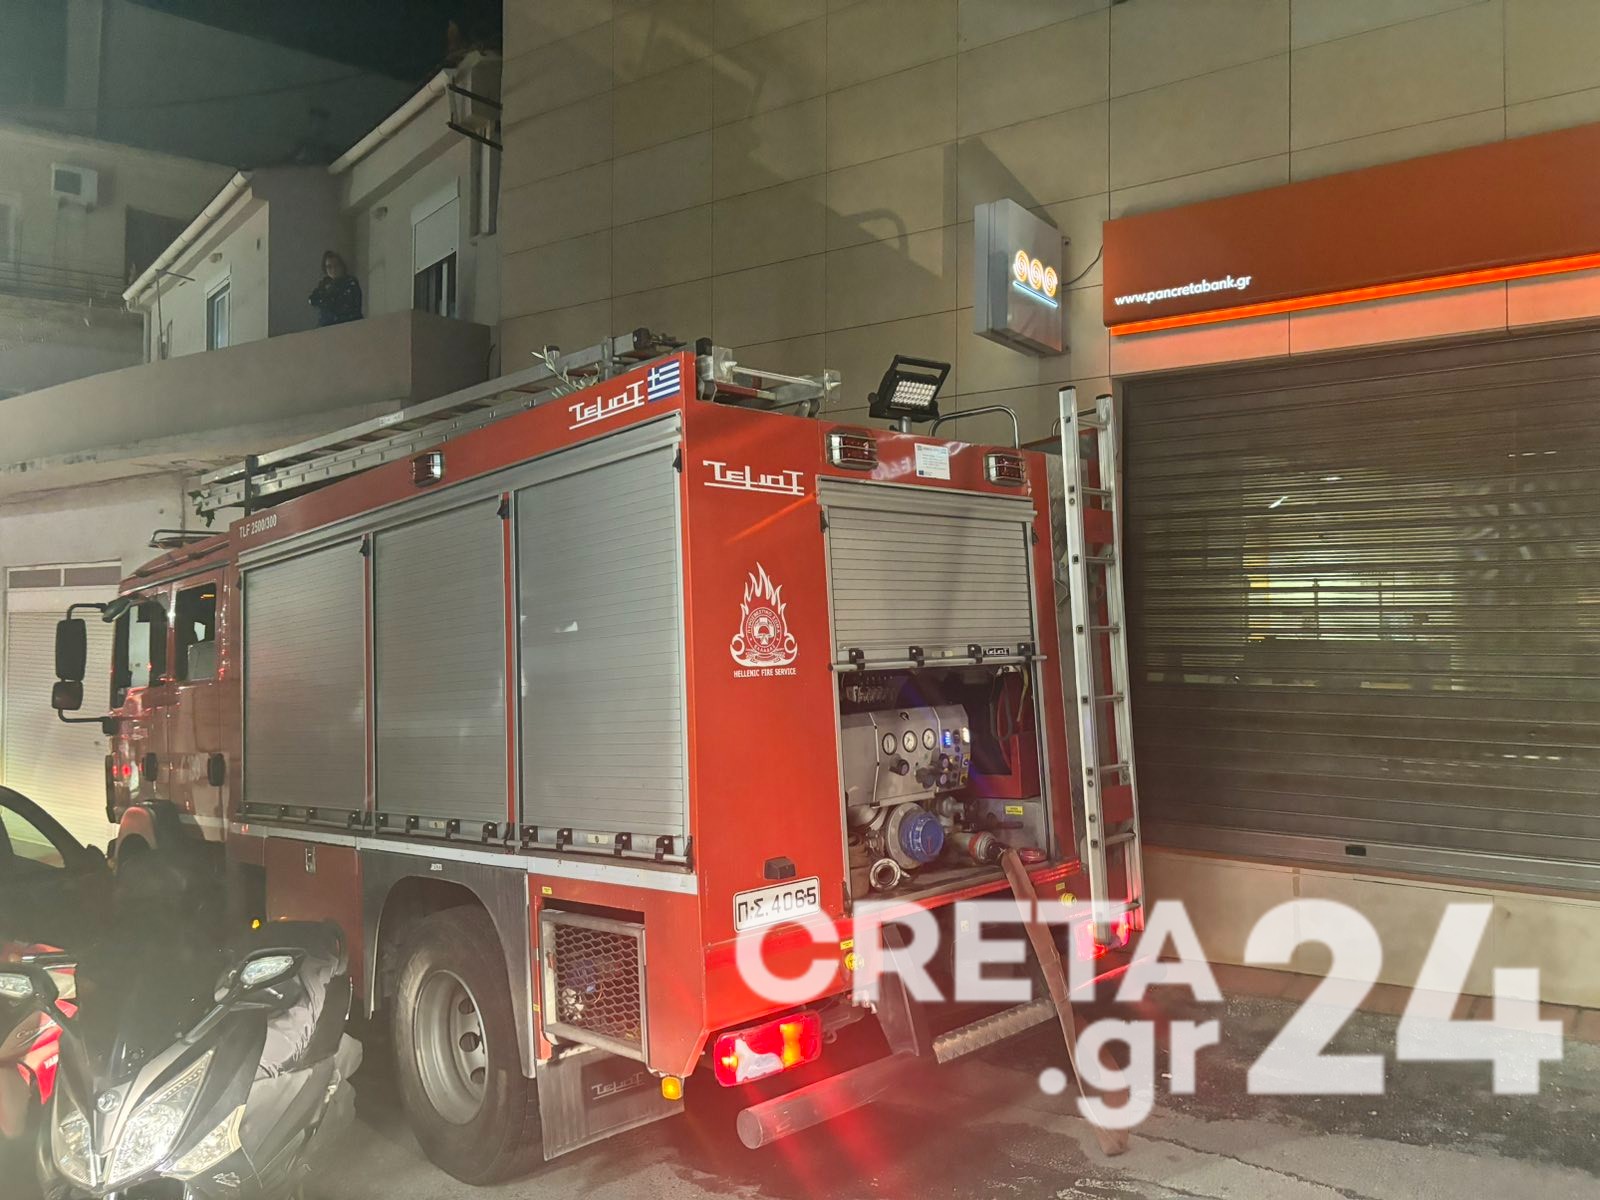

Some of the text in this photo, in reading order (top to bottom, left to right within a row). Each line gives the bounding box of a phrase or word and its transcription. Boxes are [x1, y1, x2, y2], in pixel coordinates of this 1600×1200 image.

[1114, 275, 1252, 305] www.pancretabank.gr
[239, 524, 250, 538] TLF
[733, 667, 797, 678] HELLENIC FIRE SERVICE
